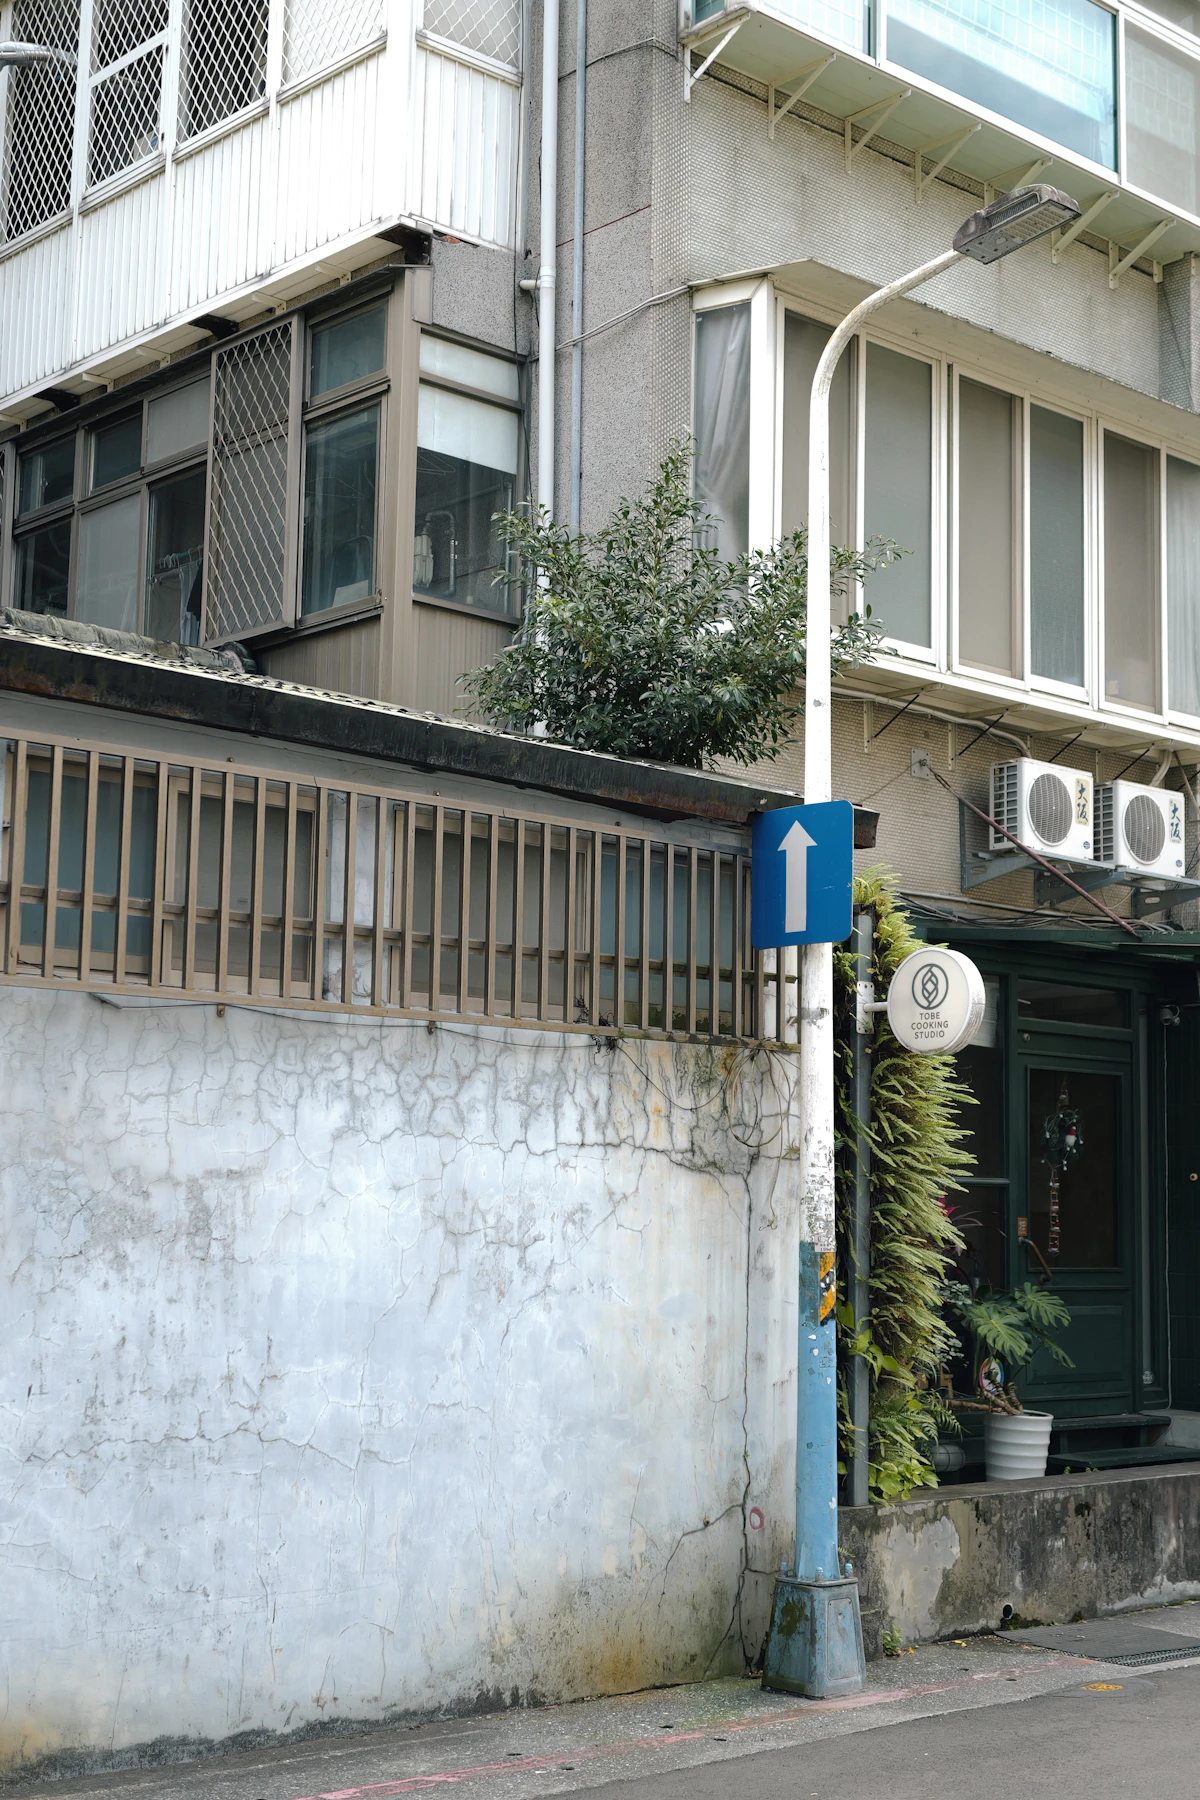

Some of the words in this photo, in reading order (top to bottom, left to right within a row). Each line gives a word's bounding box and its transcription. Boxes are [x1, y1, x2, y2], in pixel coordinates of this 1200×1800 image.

[920, 1012, 940, 1020] TOBE
[911, 1020, 948, 1030] COOKING
[914, 1030, 945, 1039] STUDIO
